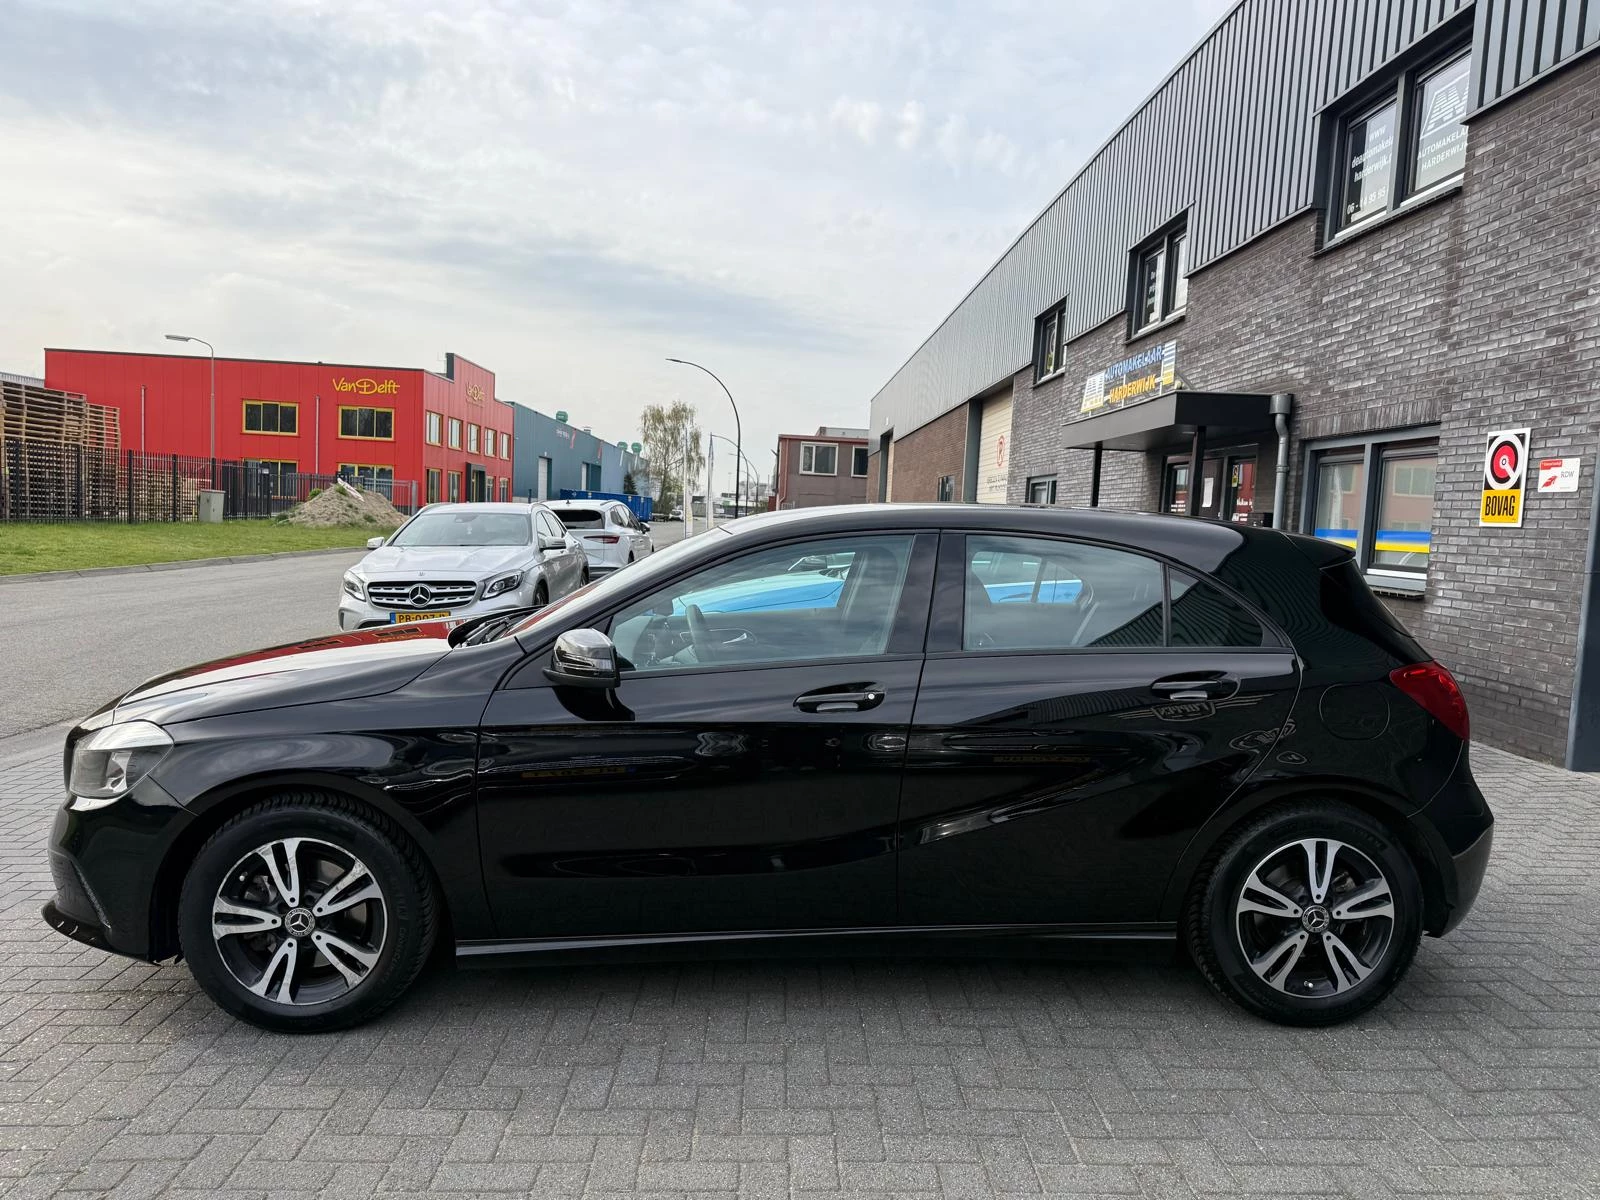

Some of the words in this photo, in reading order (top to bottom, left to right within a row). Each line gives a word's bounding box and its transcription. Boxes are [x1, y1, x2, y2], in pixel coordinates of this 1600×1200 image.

[1105, 345, 1163, 380] AUTOMAKELAAR
[1109, 374, 1157, 403] HARDERWIJK
[1560, 470, 1575, 478] RDW
[1485, 495, 1516, 516] BOVAG
